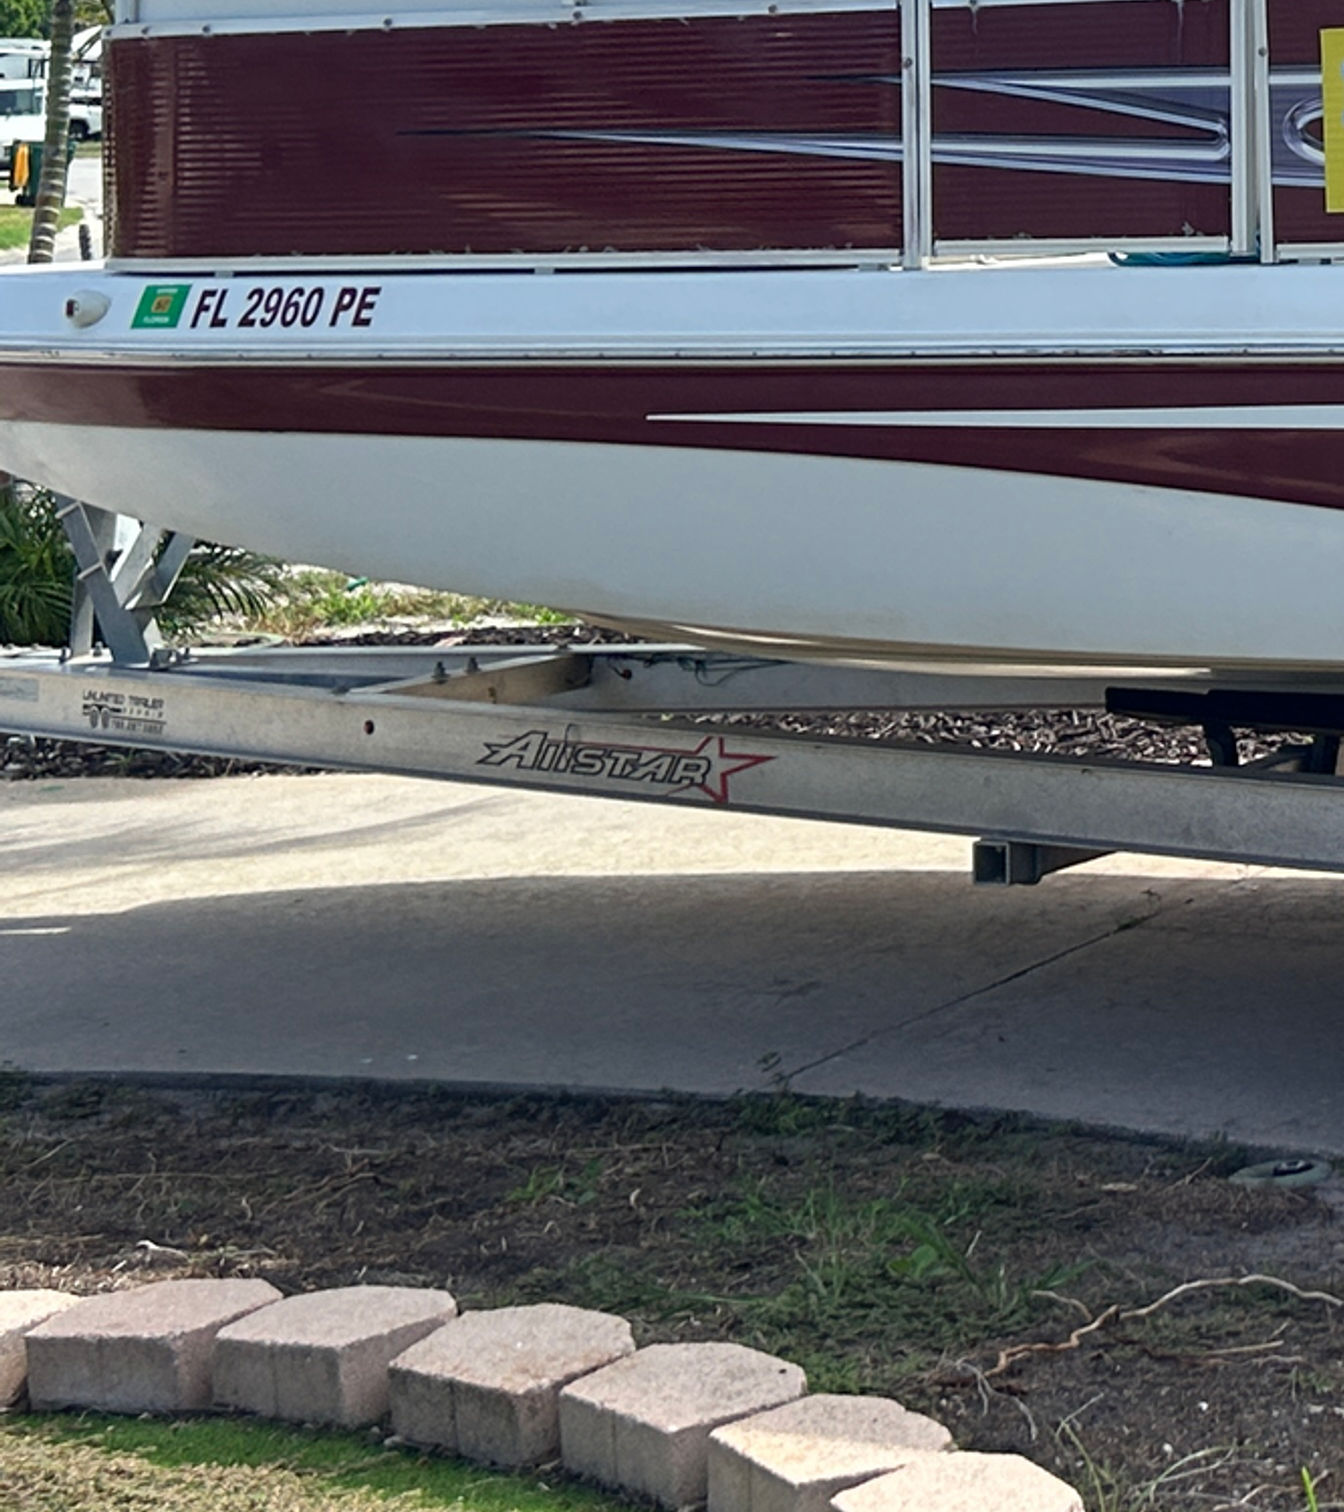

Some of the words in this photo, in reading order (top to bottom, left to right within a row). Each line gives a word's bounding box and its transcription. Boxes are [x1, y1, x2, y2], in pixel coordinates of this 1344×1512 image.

[190, 288, 230, 328] FL
[237, 287, 324, 328] 2960
[328, 287, 382, 327] PE
